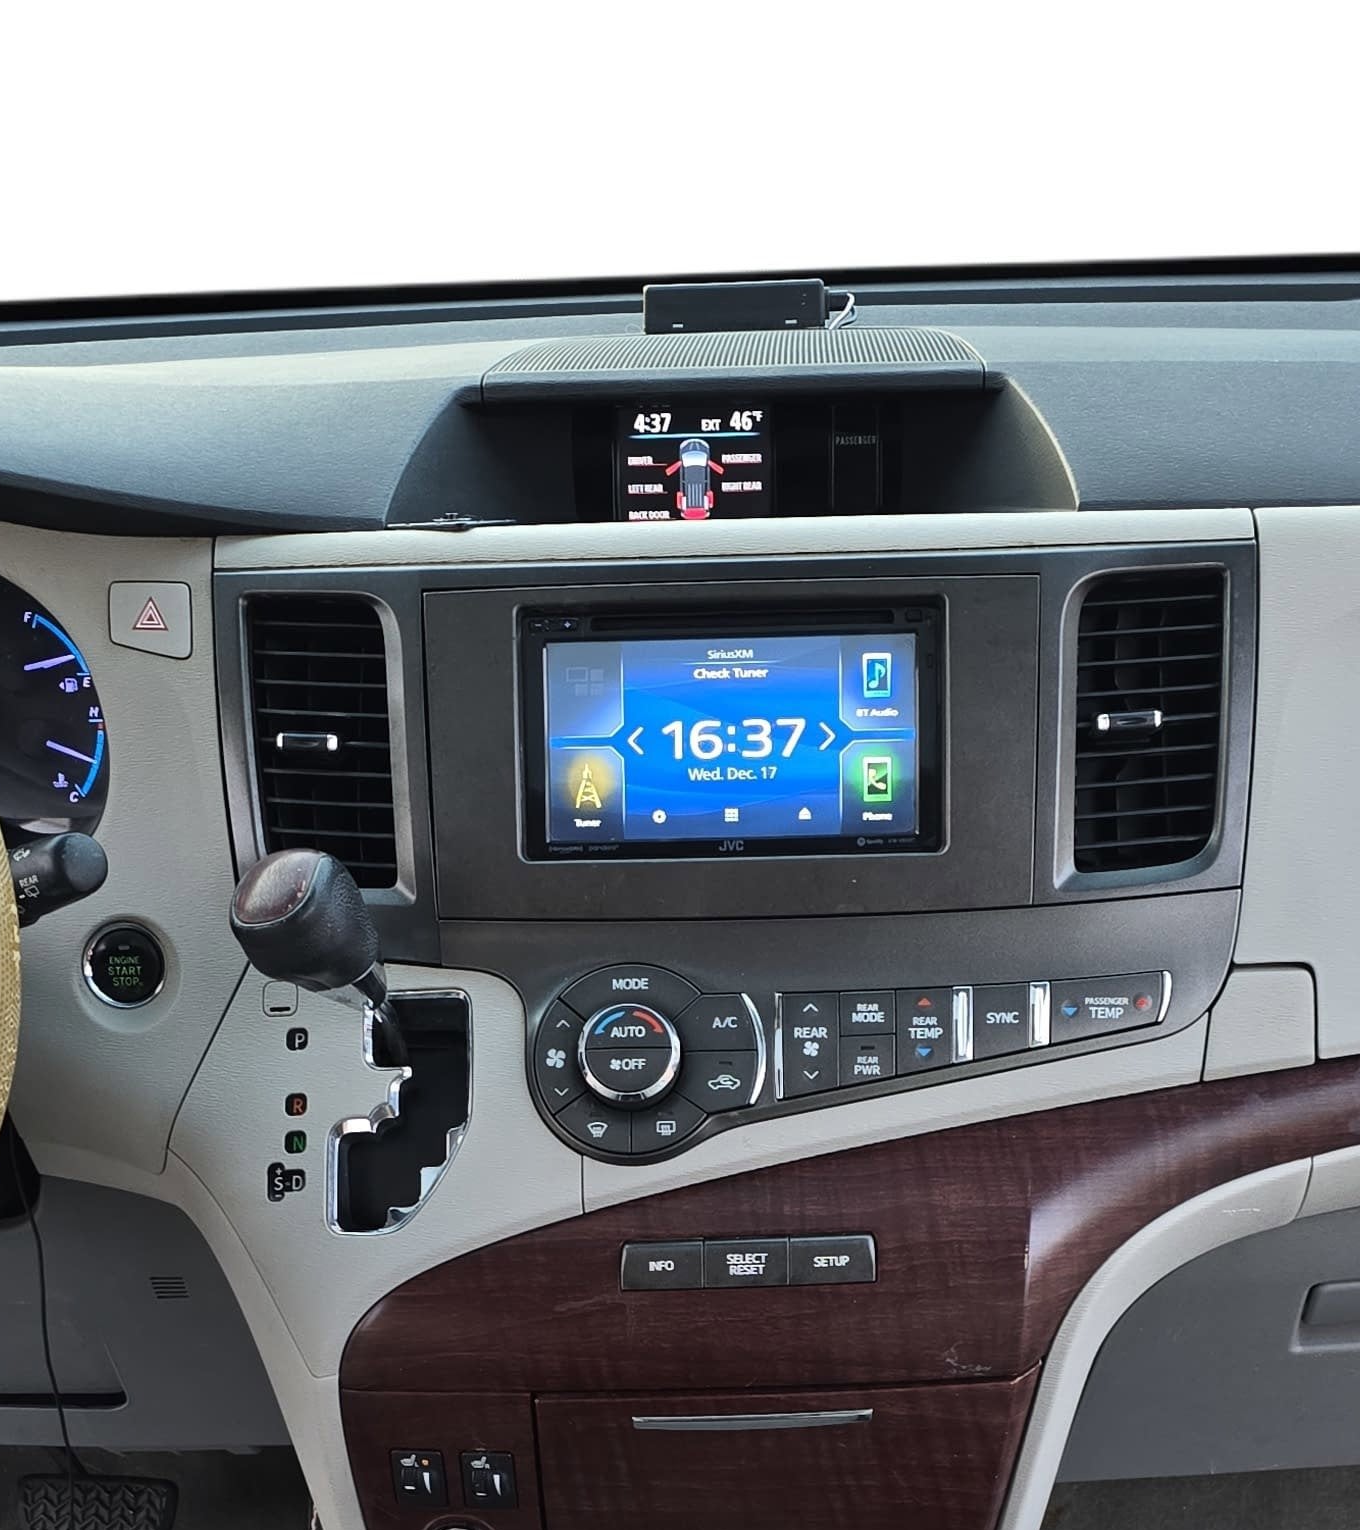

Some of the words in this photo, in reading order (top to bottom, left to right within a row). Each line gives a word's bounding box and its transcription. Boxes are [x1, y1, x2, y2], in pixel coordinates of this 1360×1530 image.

[633, 413, 672, 433] 4:37
[701, 418, 721, 431] EXT
[24, 611, 32, 623] F
[707, 649, 754, 660] SiriusXM
[693, 668, 731, 680] Check
[733, 667, 769, 679] Tuner
[82, 676, 91, 688] E
[661, 717, 806, 760] 16:37
[688, 766, 724, 781] Wed.
[727, 766, 758, 780] Dec.
[760, 765, 778, 780] 17
[69, 791, 80, 803] C
[718, 840, 744, 852] JVC
[18, 874, 40, 889] REAR
[109, 956, 140, 965] ENGINE
[108, 966, 142, 976] START
[112, 976, 140, 987] STOP
[612, 978, 649, 991] MODE
[857, 1003, 879, 1012] REAR
[1085, 996, 1129, 1007] PASSENGER
[851, 1011, 885, 1024] MODE
[986, 1011, 1019, 1025] SYNC
[1089, 1006, 1124, 1020] TEMP
[712, 1016, 738, 1029] A/C
[912, 1016, 938, 1026] REAR
[610, 1026, 646, 1038] AUTO
[793, 1026, 828, 1039] REAR
[908, 1027, 943, 1040] TEMP
[294, 1032, 305, 1048] P
[621, 1058, 647, 1070] OFF
[857, 1056, 879, 1065] REAR
[854, 1064, 881, 1076] PWR
[292, 1098, 304, 1114] R
[292, 1136, 305, 1151] N
[726, 1252, 768, 1265] SELECT
[813, 1255, 850, 1268] SETUP
[648, 1261, 675, 1272] INFO
[729, 1264, 765, 1276] RESET
